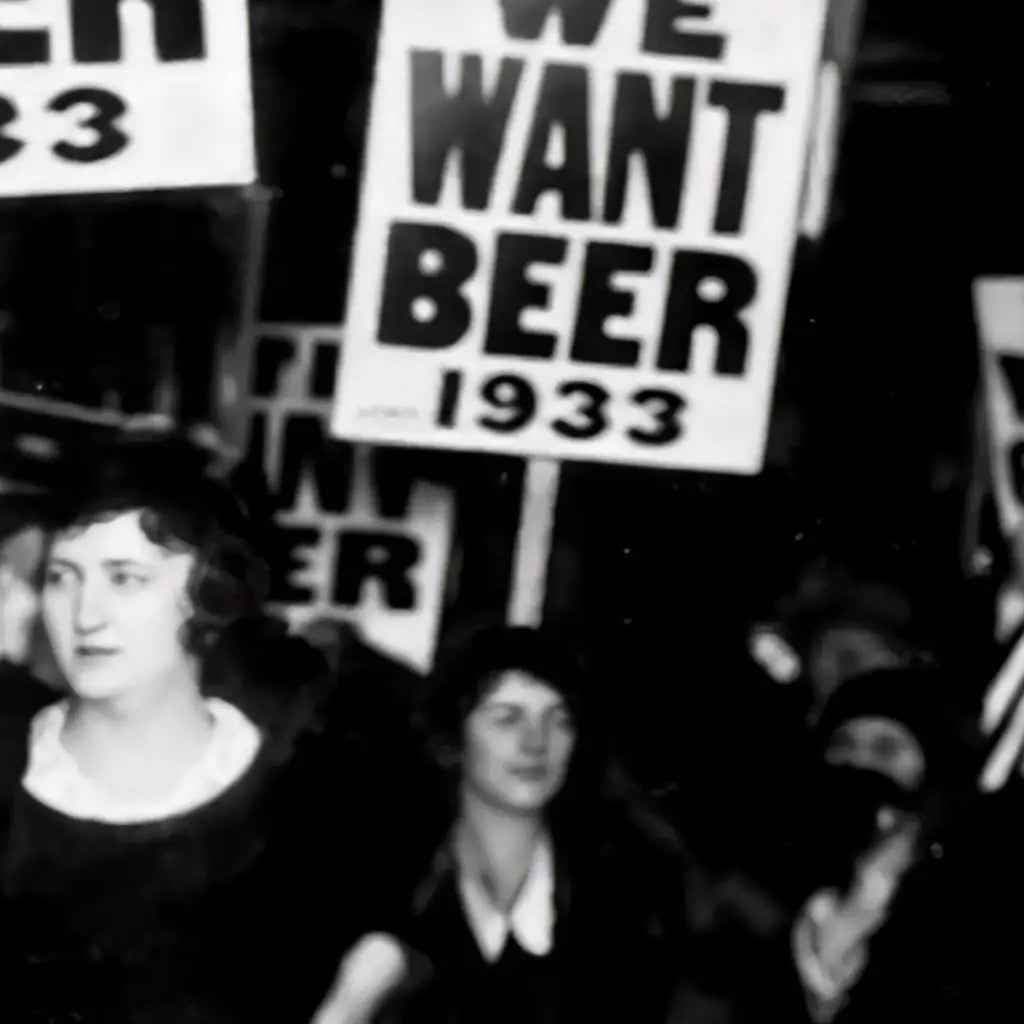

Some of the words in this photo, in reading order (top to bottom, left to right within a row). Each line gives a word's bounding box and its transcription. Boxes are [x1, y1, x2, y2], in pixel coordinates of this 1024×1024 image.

[408, 48, 786, 235] WANT
[376, 220, 760, 379] BEER
[434, 368, 689, 447] 1933
